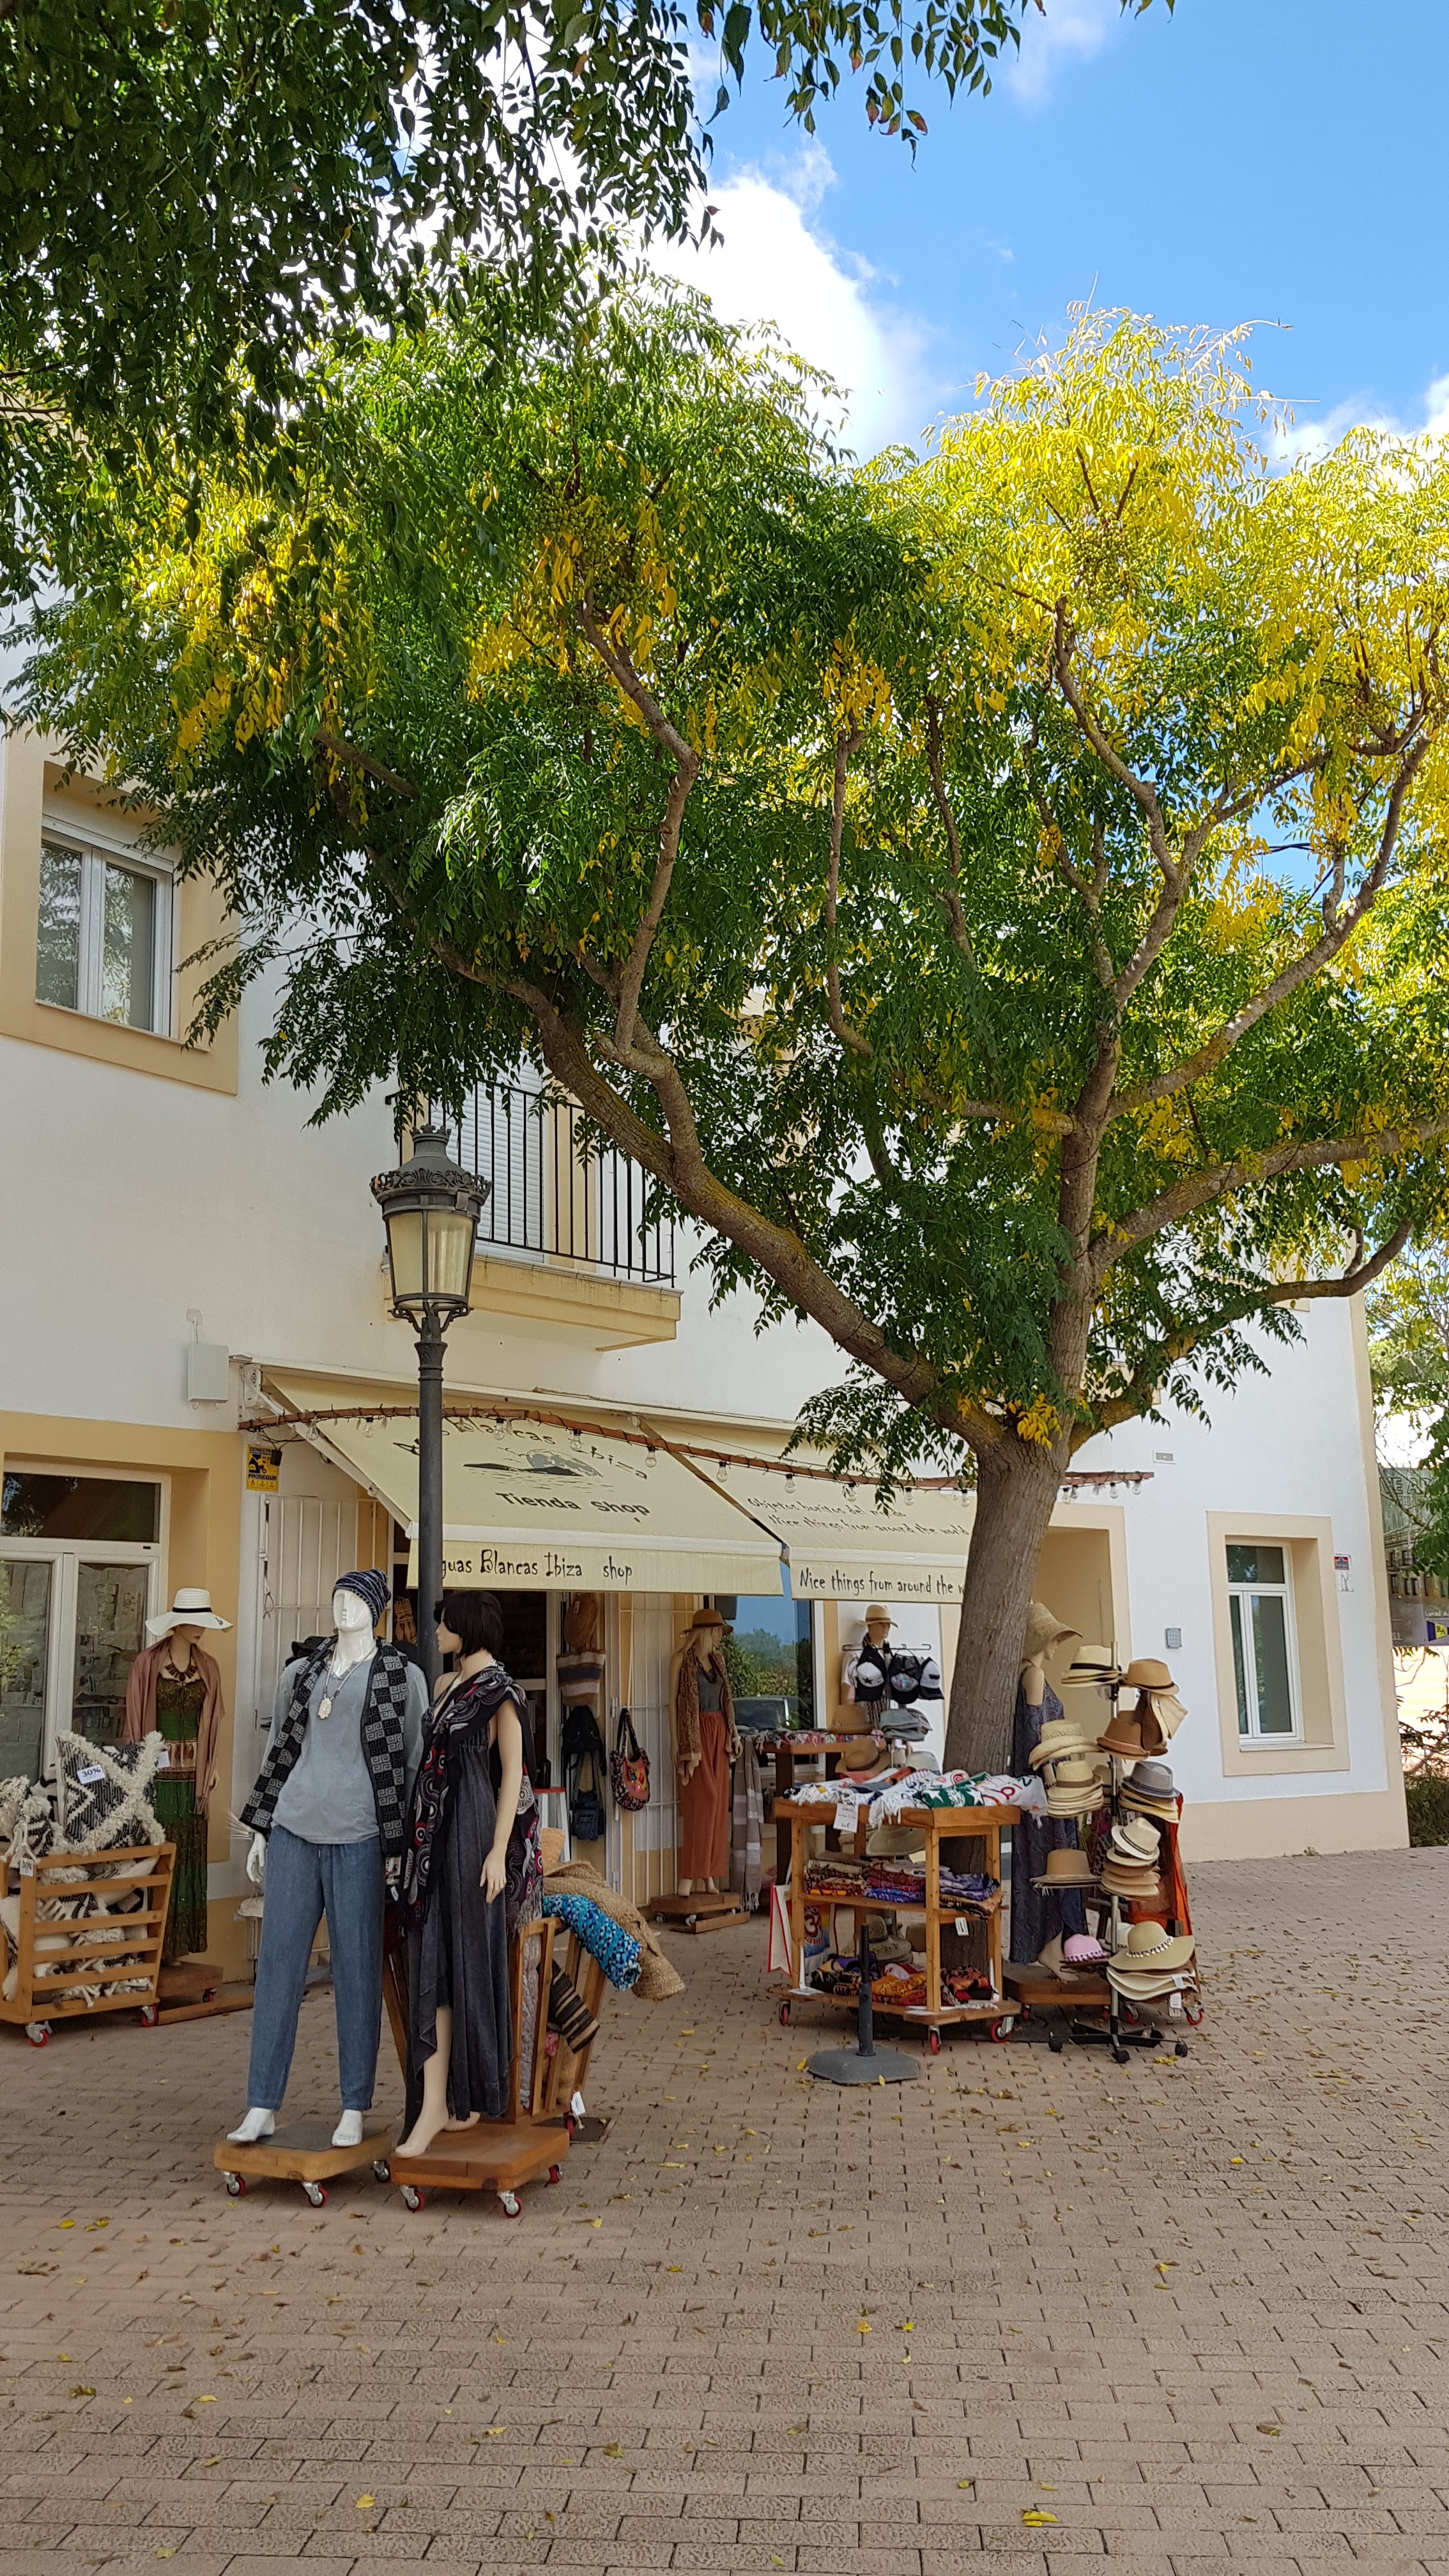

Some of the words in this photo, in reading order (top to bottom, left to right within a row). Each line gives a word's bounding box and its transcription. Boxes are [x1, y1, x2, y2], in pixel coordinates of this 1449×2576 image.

[496, 1492, 582, 1510] Tienda
[441, 1560, 472, 1579] guas
[480, 1549, 538, 1575] Blancas
[544, 1551, 583, 1578] Ibiza
[602, 1555, 632, 1586] shop
[800, 1567, 825, 1590] Nice
[831, 1569, 865, 1597] things
[868, 1570, 894, 1595] from
[898, 1574, 931, 1595] around
[936, 1574, 953, 1595] the
[82, 1767, 101, 1777] 30%
